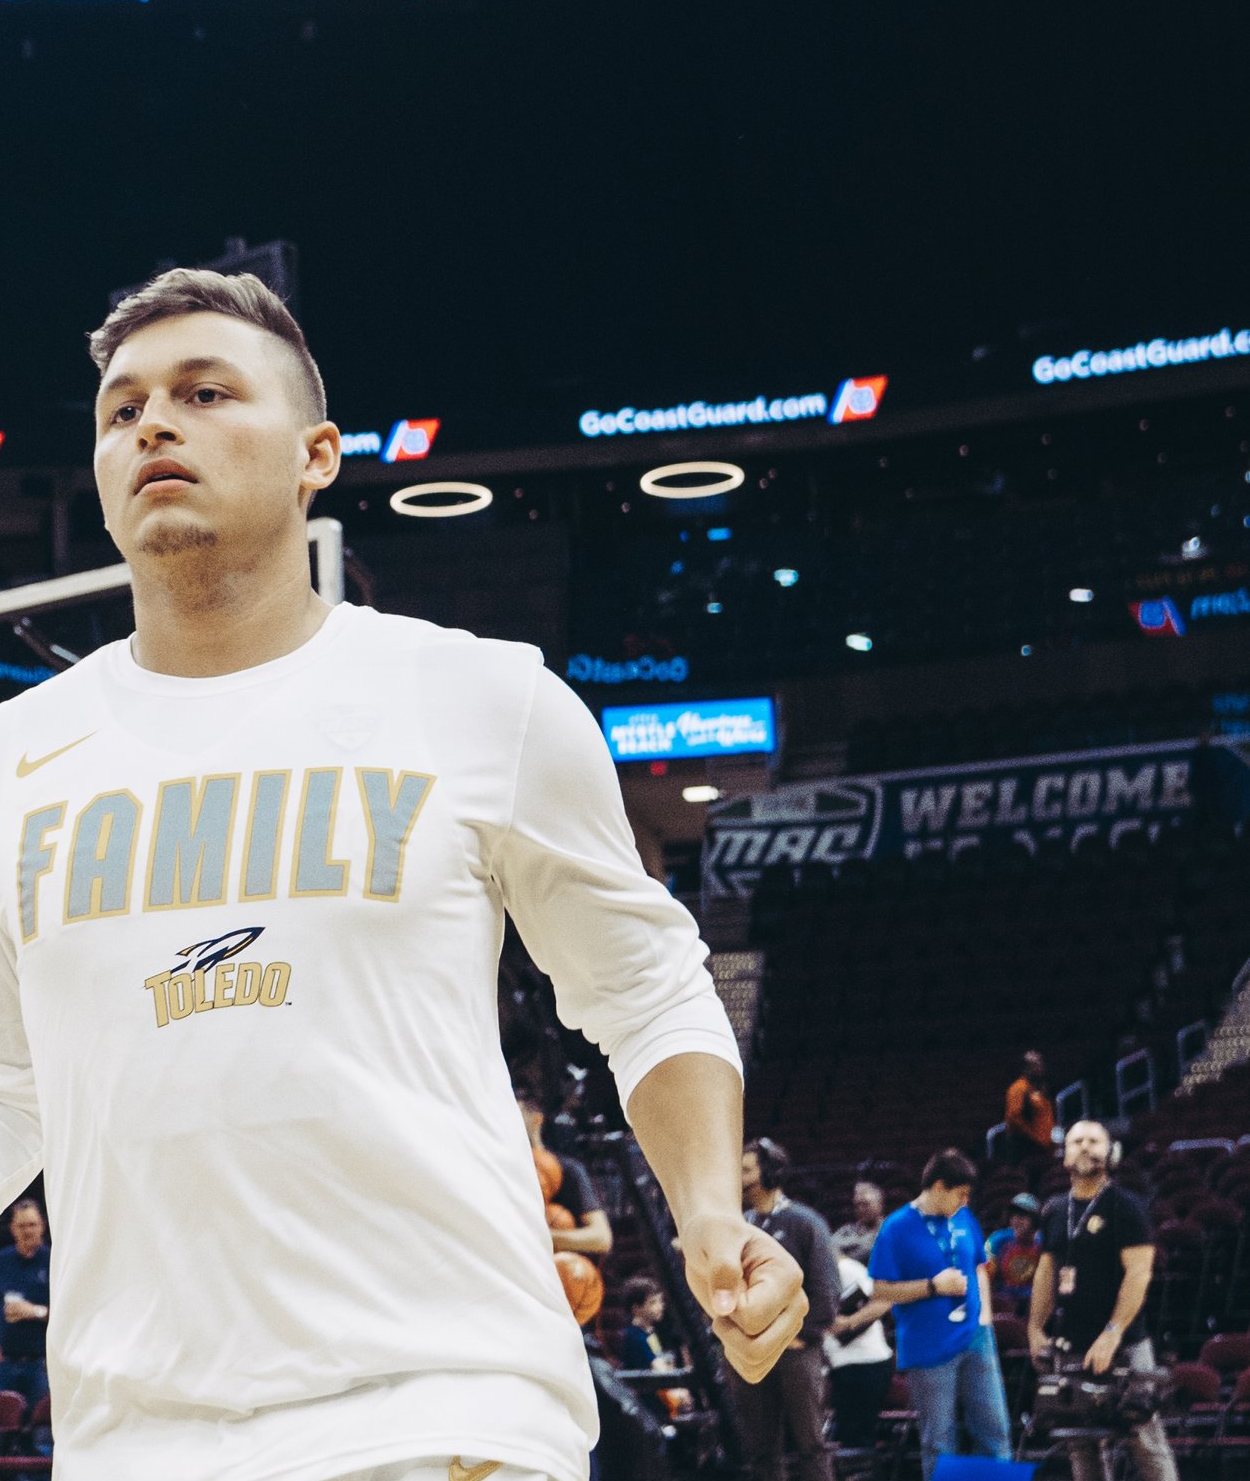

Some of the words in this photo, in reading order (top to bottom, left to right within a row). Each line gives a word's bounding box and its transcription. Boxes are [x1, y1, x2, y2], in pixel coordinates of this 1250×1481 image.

[1033, 328, 1250, 384] GoCoastGuard.c
[579, 392, 826, 436] GoCoastGuard.com
[901, 760, 1191, 833] WELCOME
[15, 766, 438, 945] FAMILY
[711, 823, 862, 867] MAC
[144, 961, 292, 1029] TOLEDO
